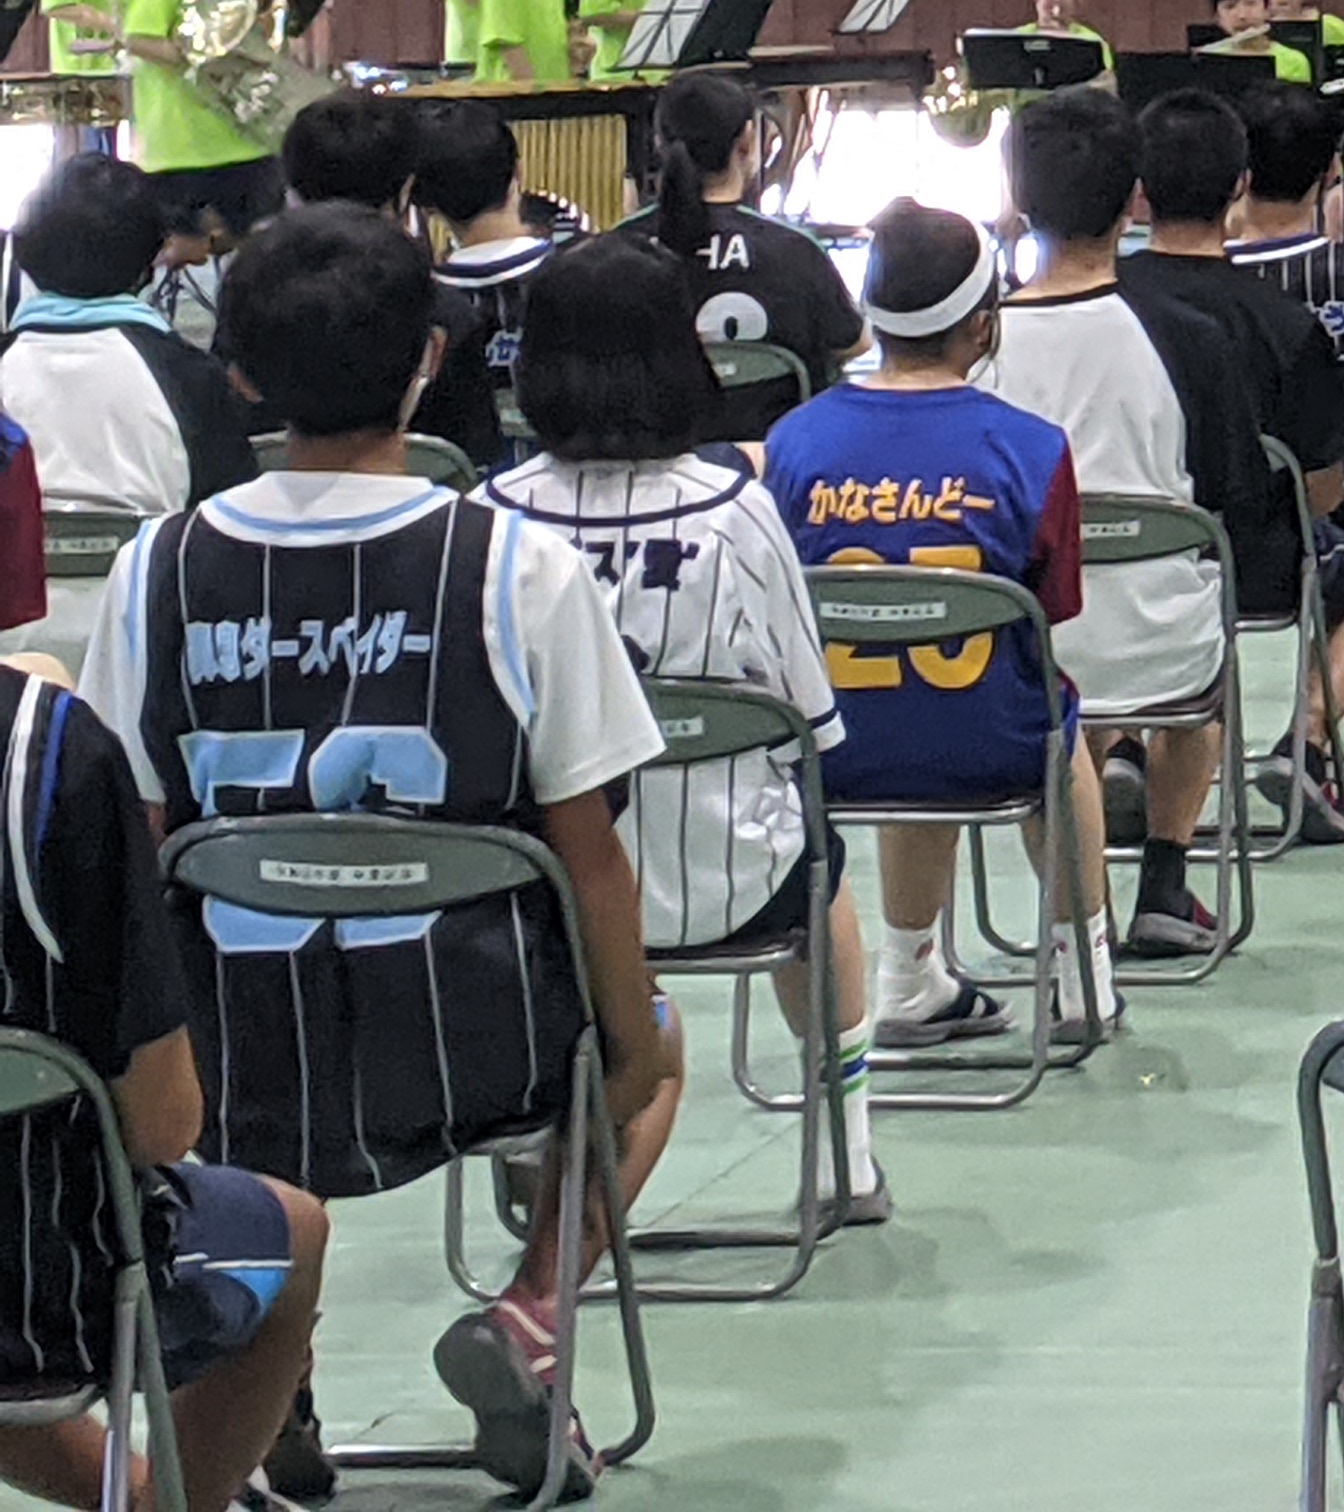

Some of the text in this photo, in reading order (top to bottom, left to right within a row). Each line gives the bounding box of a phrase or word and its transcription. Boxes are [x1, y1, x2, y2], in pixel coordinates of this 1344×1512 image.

[807, 476, 996, 526] かなさんどー
